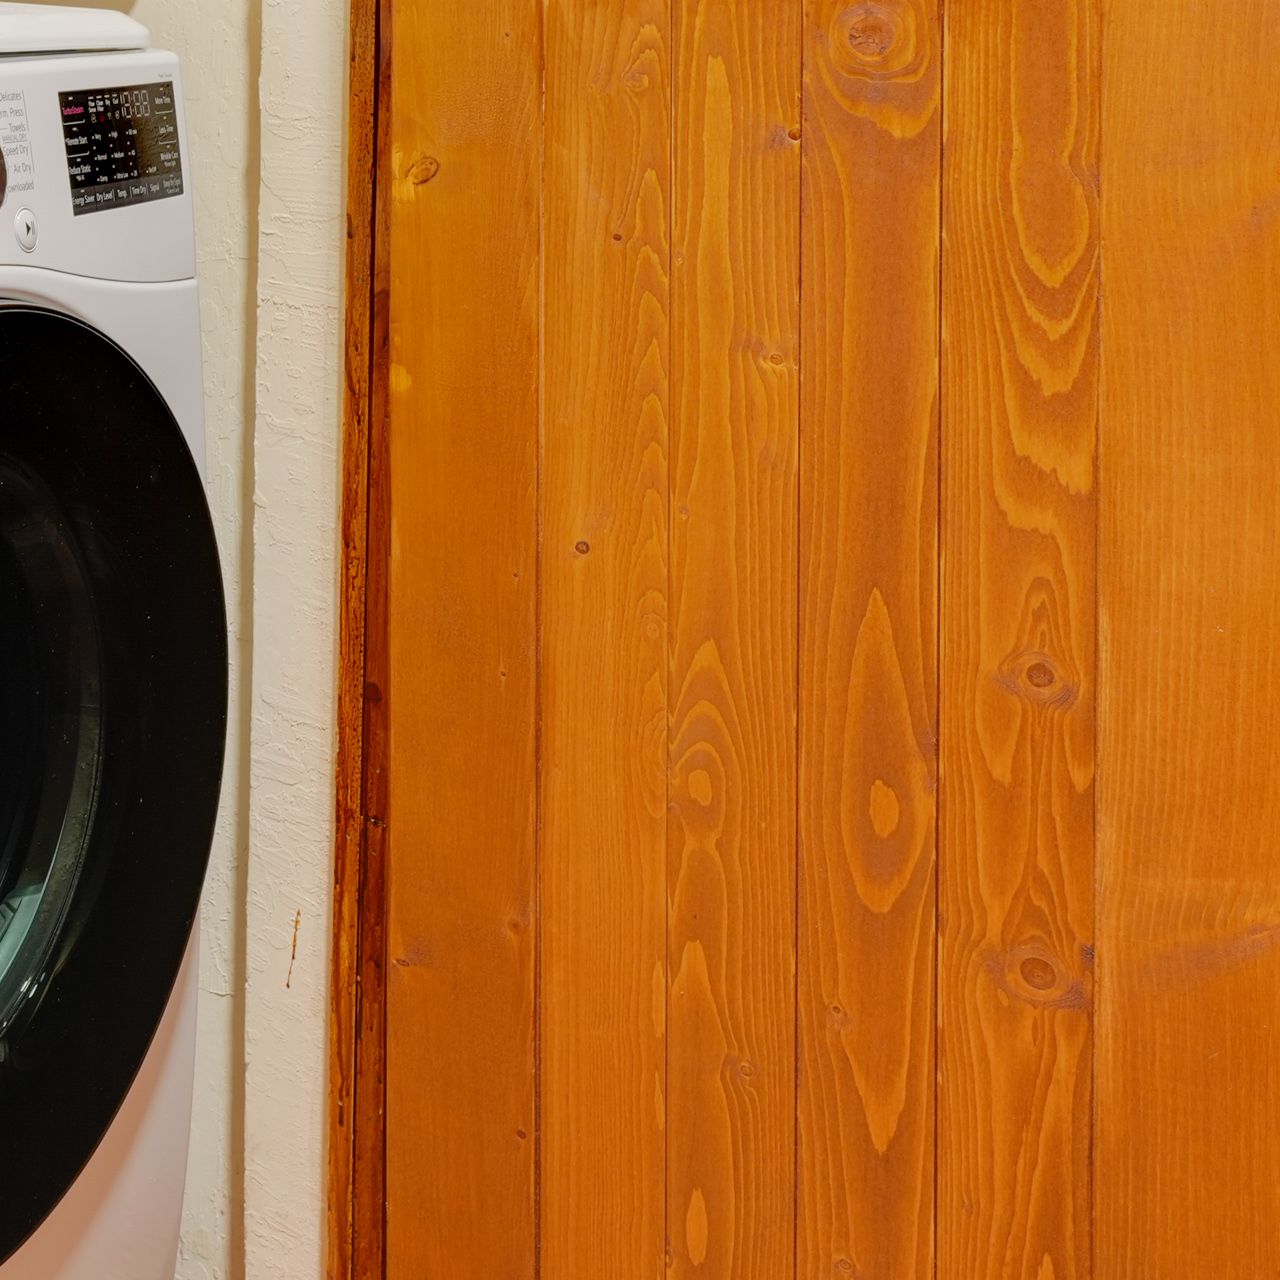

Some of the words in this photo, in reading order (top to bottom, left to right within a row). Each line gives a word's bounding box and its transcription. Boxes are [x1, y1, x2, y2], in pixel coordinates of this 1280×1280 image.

[9, 107, 24, 117] Press
[8, 122, 26, 133] Towels
[19, 144, 30, 156] Dry
[21, 162, 32, 174] Dry
[7, 180, 35, 192] ownloaded
